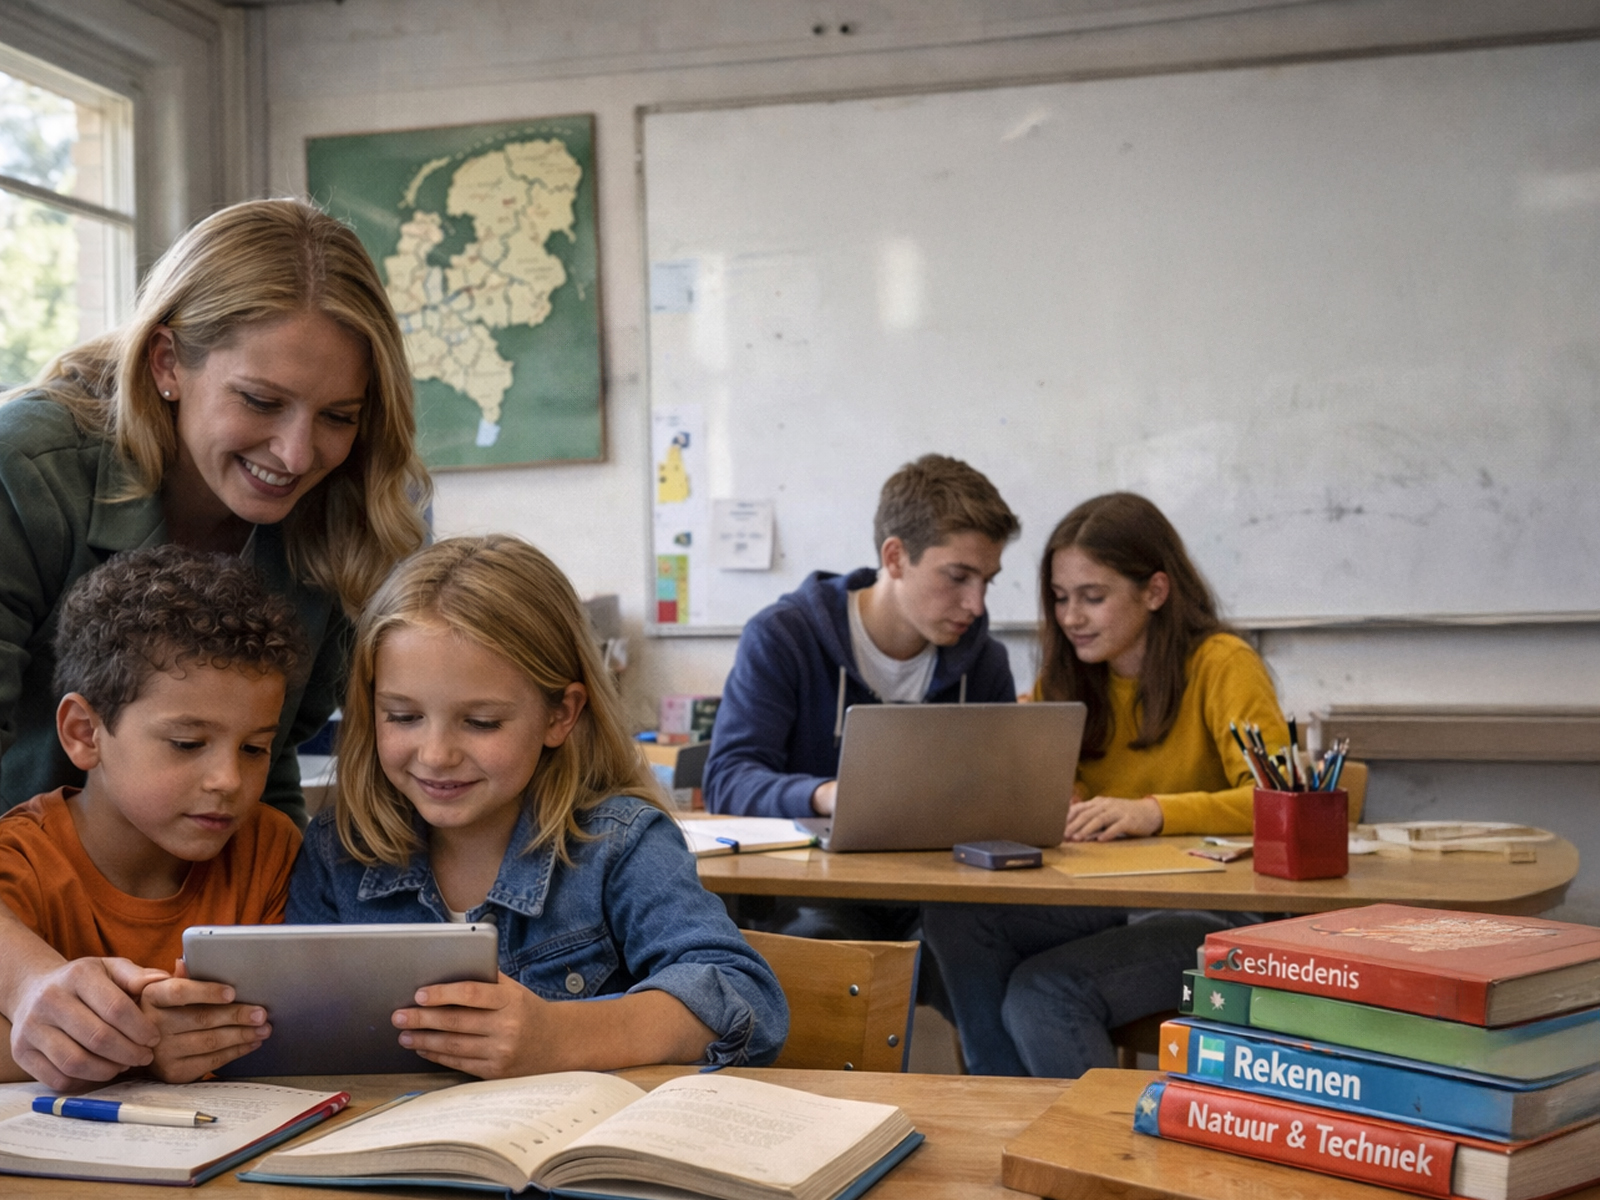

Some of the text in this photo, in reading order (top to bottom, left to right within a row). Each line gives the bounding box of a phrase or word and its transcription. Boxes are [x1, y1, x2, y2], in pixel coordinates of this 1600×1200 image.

[1234, 1045, 1361, 1100] Rekenen
[1187, 1101, 1434, 1176] Natuur & Techniek
